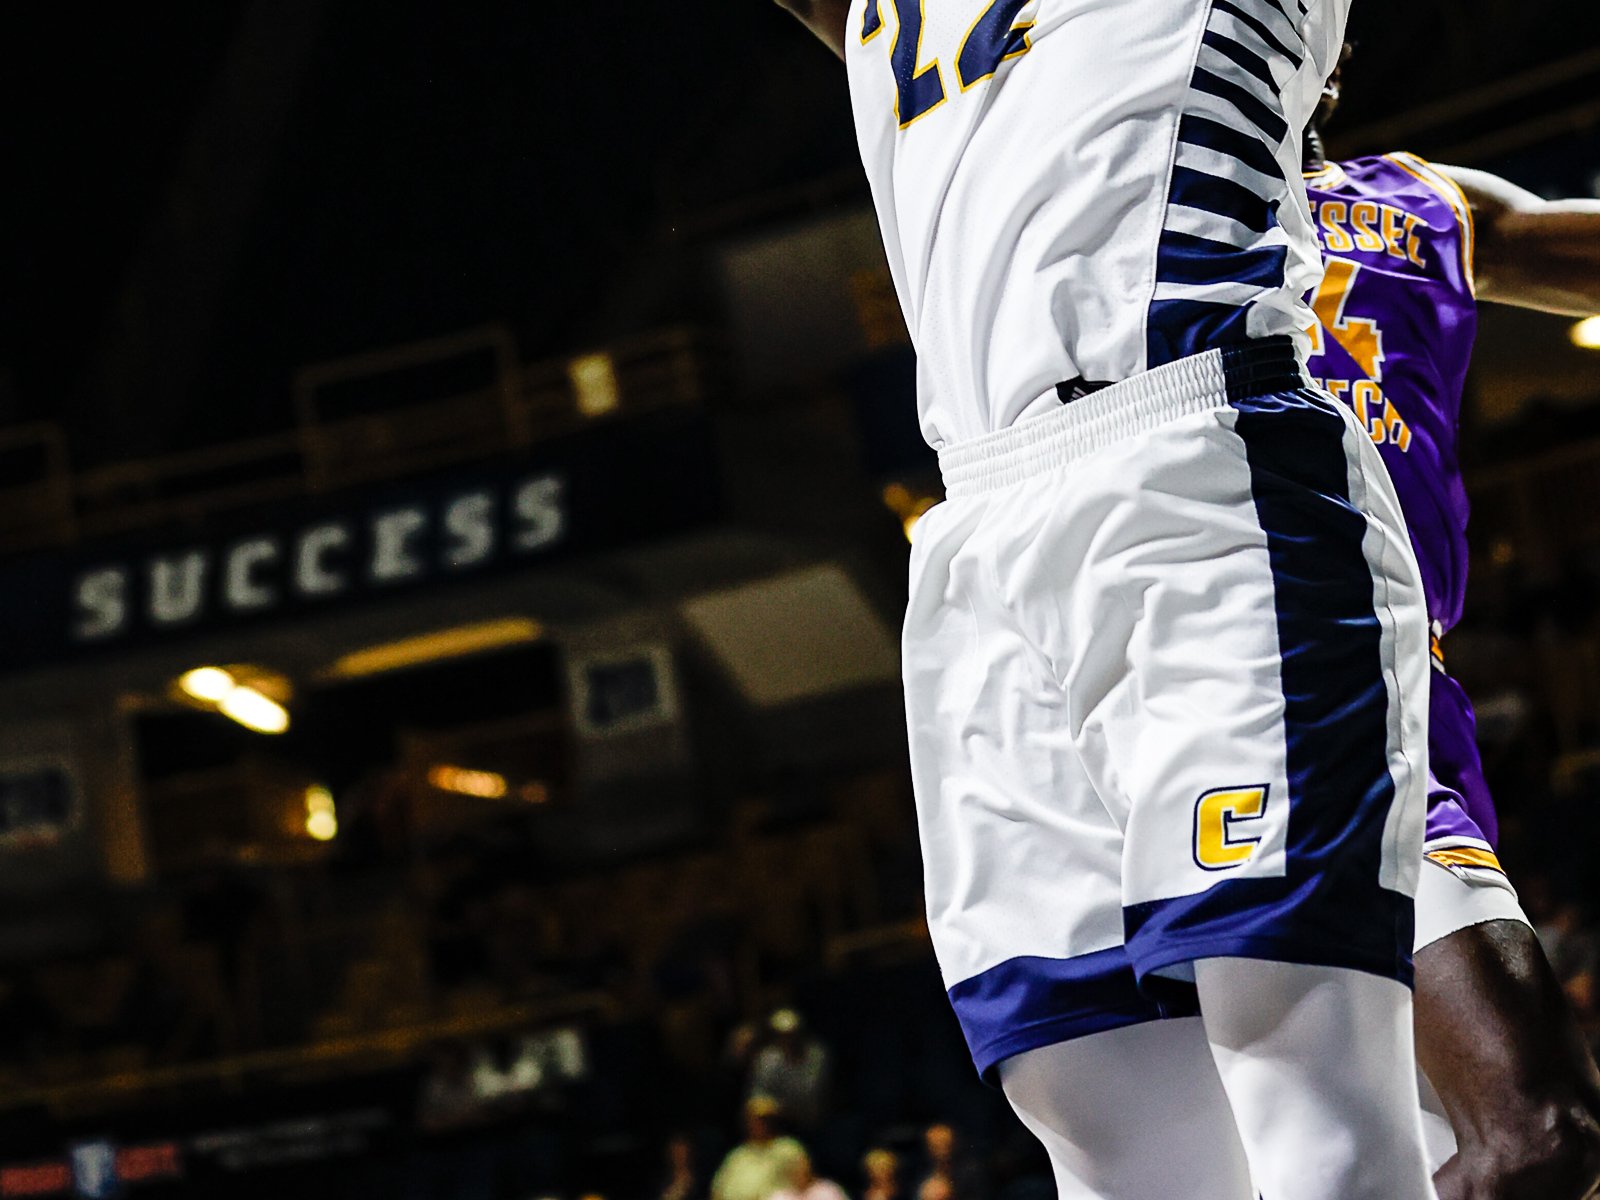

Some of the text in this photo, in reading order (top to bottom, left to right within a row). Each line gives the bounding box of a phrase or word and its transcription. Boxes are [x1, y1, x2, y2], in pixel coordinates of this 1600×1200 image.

[1309, 200, 1428, 268] SSEE
[1304, 255, 1386, 382] 4
[1314, 378, 1411, 452] CH
[76, 476, 563, 639] SUCCESS
[1192, 783, 1270, 871] C
